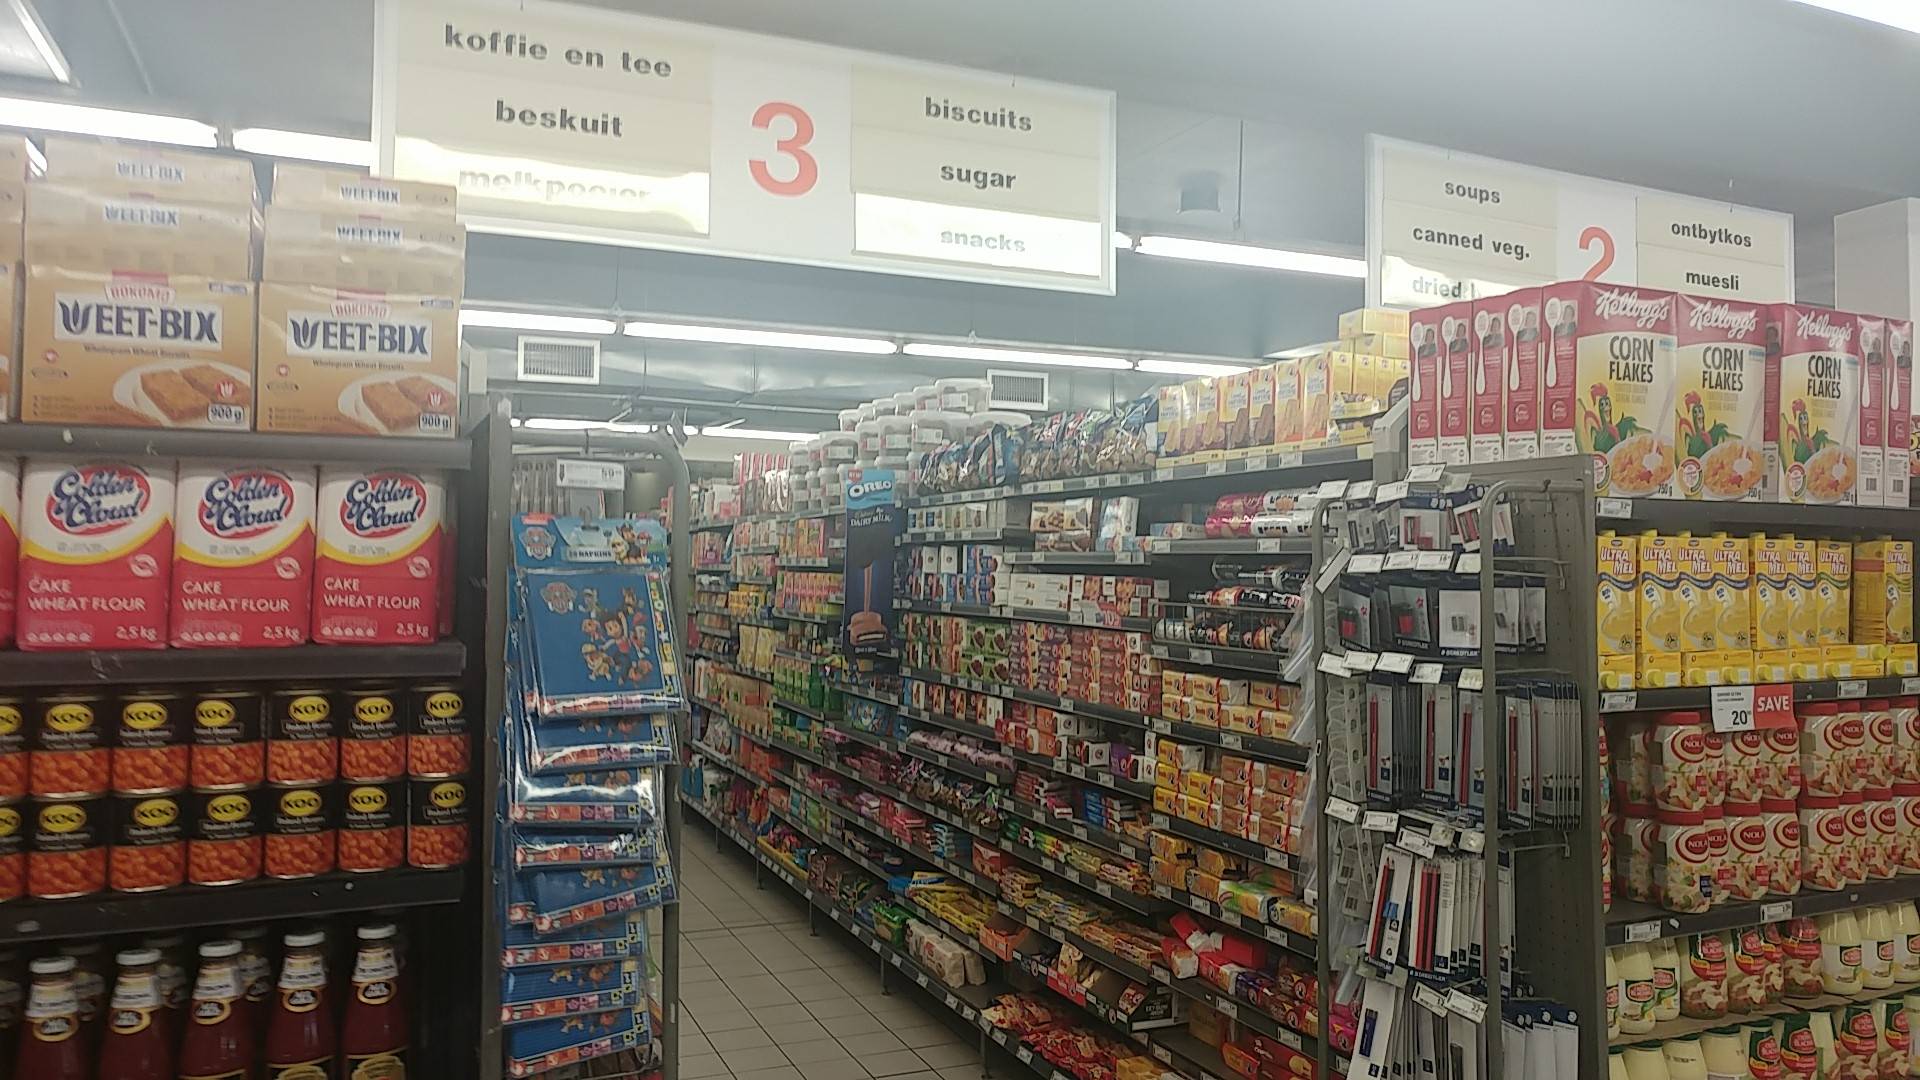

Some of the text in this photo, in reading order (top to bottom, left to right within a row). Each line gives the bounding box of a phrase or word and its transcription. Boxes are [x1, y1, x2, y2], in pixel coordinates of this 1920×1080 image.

[445, 23, 671, 78] koffie en tee
[496, 100, 623, 137] beskuit
[925, 96, 1032, 132] biscuits
[749, 102, 817, 197] 3
[940, 165, 1016, 190] sugar
[1444, 182, 1501, 204] soups
[940, 230, 1025, 252] snacks
[1413, 227, 1530, 260] canned veg.
[1671, 223, 1752, 248] ontbytkos
[1579, 227, 1615, 282] 2
[1412, 276, 1461, 298] dried
[1686, 271, 1739, 291] muesli
[1595, 289, 1668, 328] Kellogg's
[57, 299, 218, 343] WEET-BIX
[1690, 301, 1758, 339] Kellogg's
[289, 317, 428, 355] WEET-BIX
[1797, 311, 1852, 348] Kellogg's
[1609, 336, 1654, 363] CORN
[1702, 345, 1743, 371] CORN
[1609, 361, 1653, 383] FLAKES
[1807, 355, 1841, 380] CORN
[1702, 370, 1743, 391] FLAKES
[1807, 379, 1841, 399] FLAKES
[210, 407, 230, 420] 900
[422, 416, 439, 429] 900
[849, 480, 892, 498] OREO
[64, 491, 143, 528] Cloud
[215, 496, 287, 531] Cloud
[356, 495, 420, 531] Cloud
[1600, 547, 1629, 562] ULTRA
[1643, 547, 1672, 561] ULTRA
[1678, 548, 1706, 561] ULTRA
[1714, 549, 1741, 562] ULTRA
[1757, 551, 1781, 563] ULTRA
[1786, 551, 1810, 563] ULTRA
[1819, 552, 1845, 563] ULTRA
[1613, 561, 1634, 575] MEL
[1657, 561, 1678, 575] MEL
[1691, 561, 1712, 575] MEL
[1727, 562, 1747, 576] MEL
[1768, 561, 1786, 576] MEL
[1798, 561, 1815, 575] MEL
[1831, 561, 1849, 576] MEL
[28, 579, 71, 593] CAKE
[182, 581, 222, 595] CAKE
[324, 577, 360, 591] CAKE
[27, 597, 146, 612] WHEAT FLOUR
[182, 598, 290, 612] WHEAT FLOUR
[323, 594, 421, 609] WHEAT FLOUR
[357, 703, 391, 715] KOO
[429, 699, 461, 710] KOO
[1757, 695, 1789, 712] SAVE
[1732, 710, 1747, 725] 20
[433, 790, 464, 800] KOO
